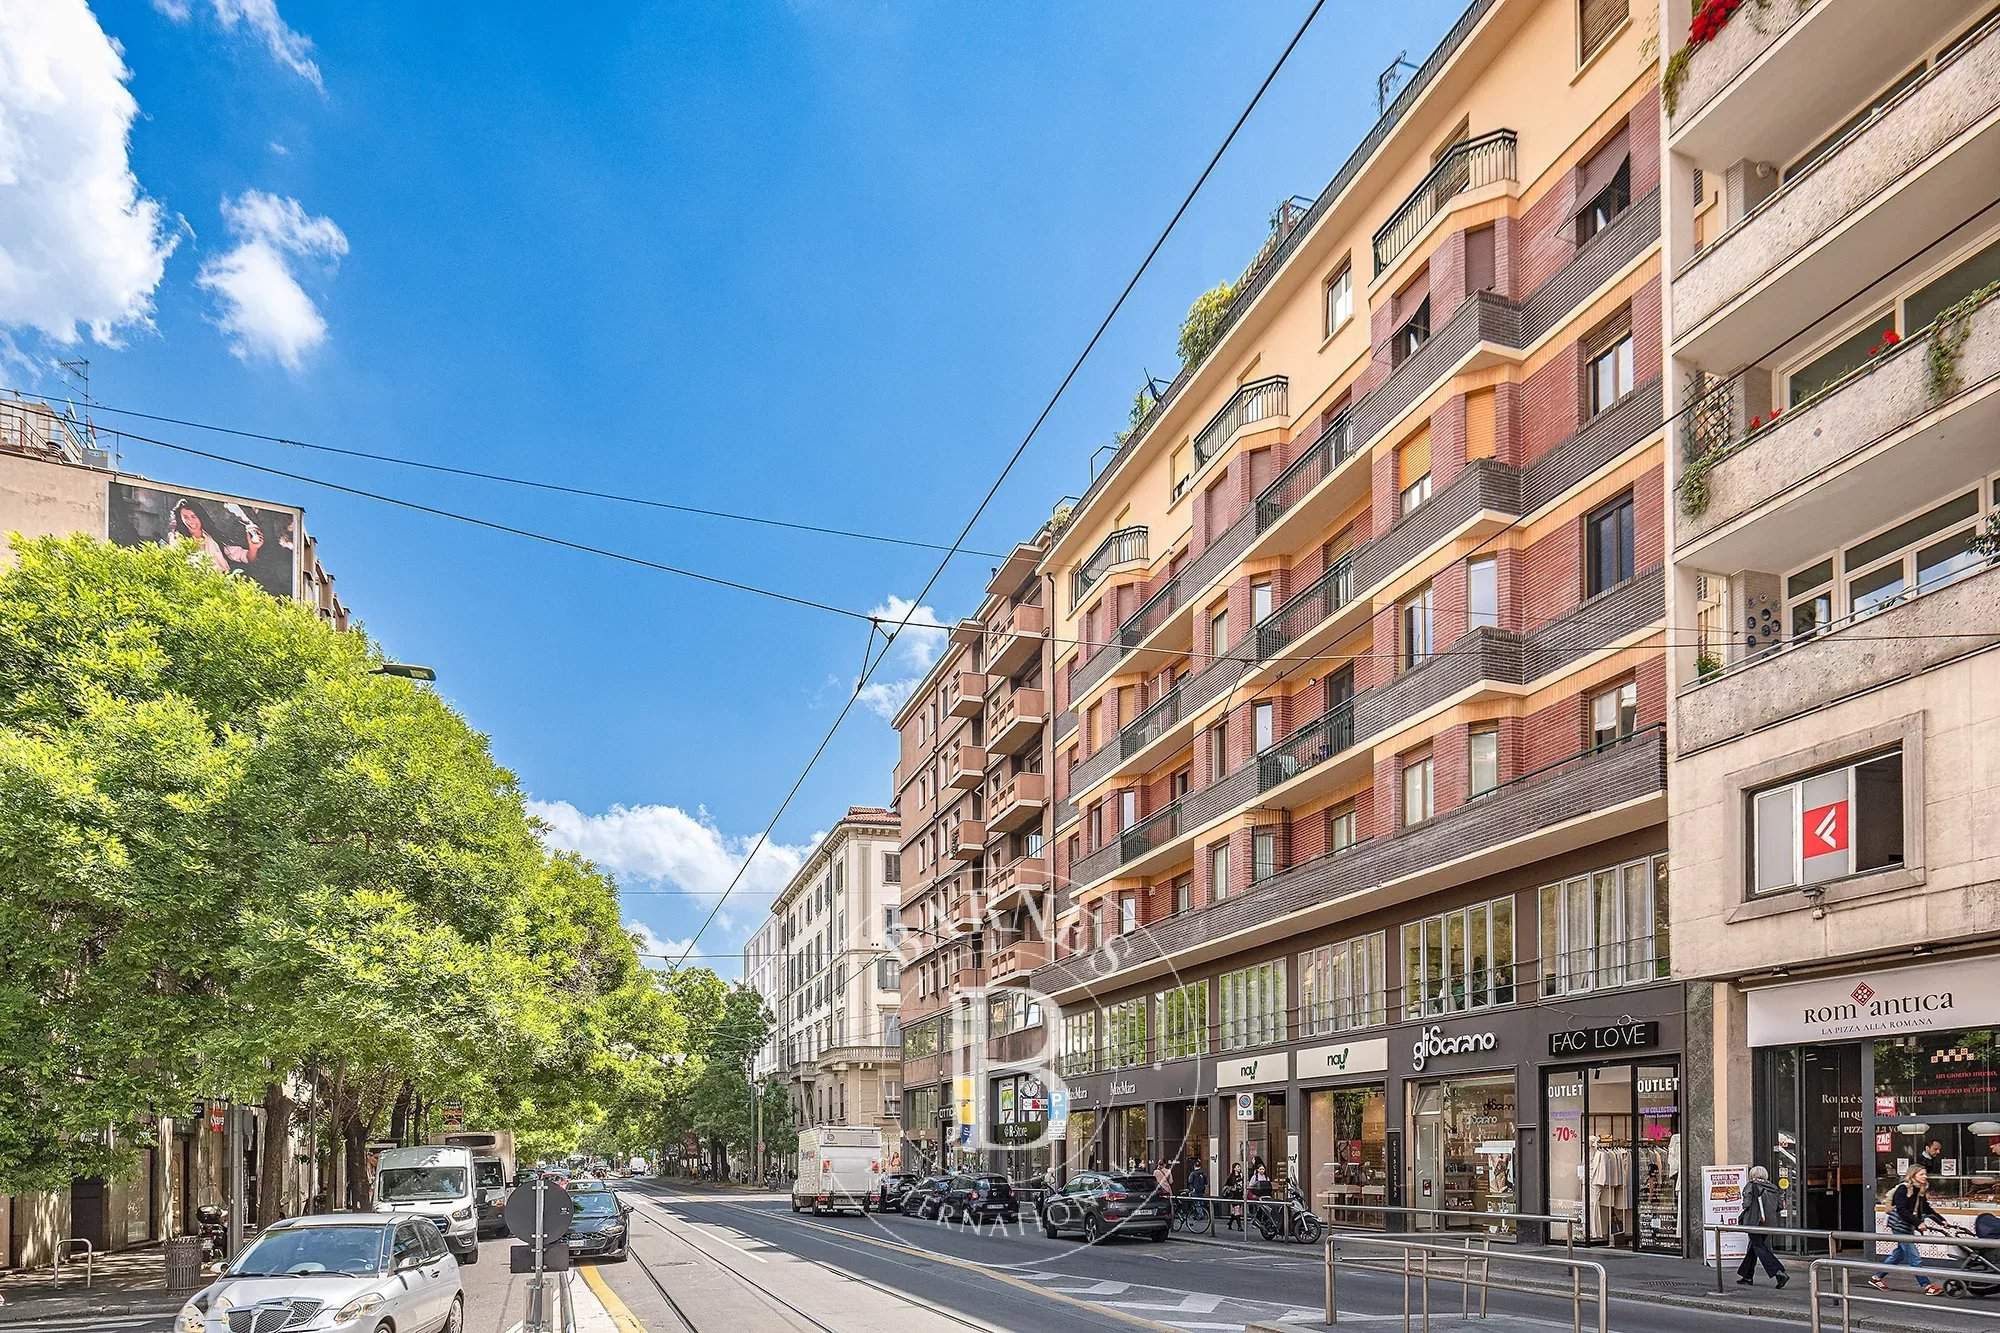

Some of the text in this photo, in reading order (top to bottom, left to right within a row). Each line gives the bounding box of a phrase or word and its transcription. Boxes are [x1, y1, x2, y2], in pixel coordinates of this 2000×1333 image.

[1835, 1025, 1860, 1034] PIZZA
[1863, 1023, 1886, 1031] ALLA
[1890, 1018, 1933, 1029] ROMANA
[1552, 1024, 1645, 1053] FAC LOVE
[1548, 1084, 1584, 1098] OUTLET
[1637, 1077, 1680, 1093] OUTLET
[1052, 1093, 1061, 1107] P
[1553, 1127, 1577, 1141] -70%
